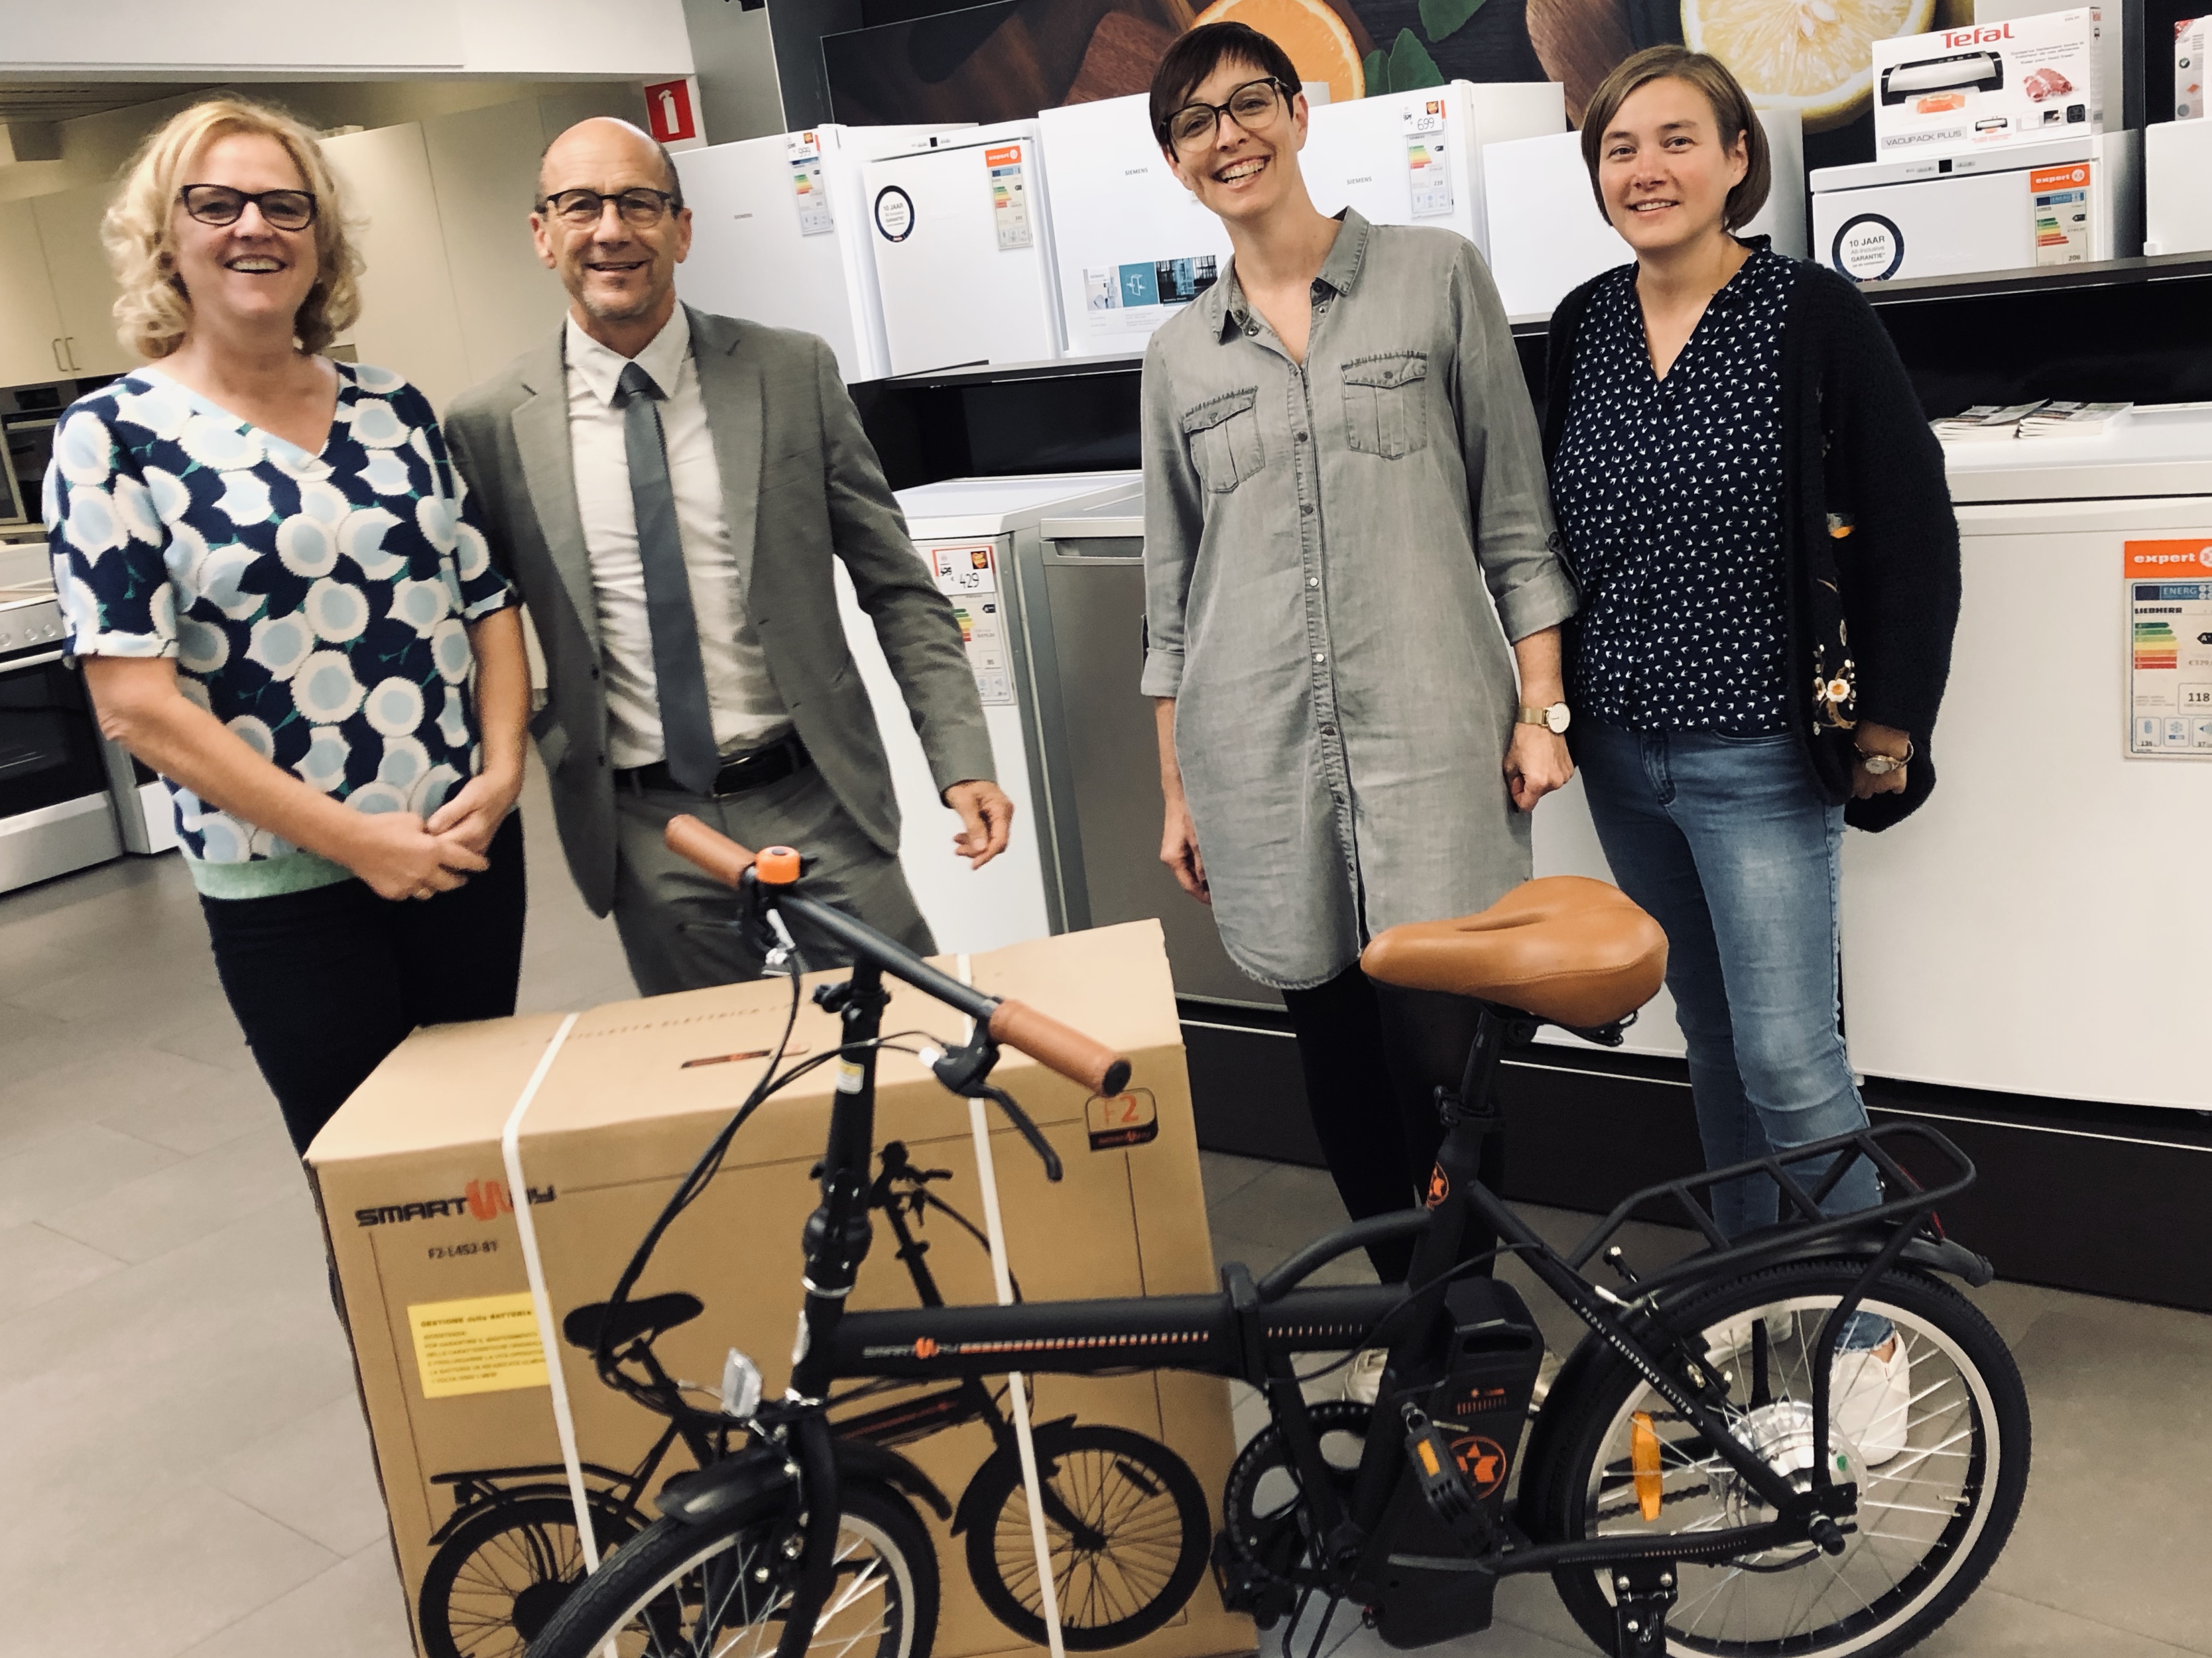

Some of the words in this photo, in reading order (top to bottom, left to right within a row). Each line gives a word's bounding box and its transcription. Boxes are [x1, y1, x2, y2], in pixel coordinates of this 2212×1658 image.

[1941, 23, 2014, 48] Tefal
[1417, 117, 1435, 131] 699
[1886, 131, 1936, 146] VACUPACK
[1937, 130, 1962, 141] PLUS
[798, 147, 811, 158] 999
[1125, 167, 1148, 176] SIEMENS
[1347, 176, 1373, 185] SIEMENS
[2036, 174, 2070, 184] expert
[1849, 239, 1859, 248] 10
[1861, 235, 1886, 247] JAAR
[2134, 553, 2196, 564] expert
[959, 572, 980, 589] 429
[2188, 693, 2210, 702] 118
[1102, 1093, 1139, 1124] F2
[1609, 1334, 1660, 1384] ASSISTANCE
[1662, 1383, 1693, 1415] SYSTEM
